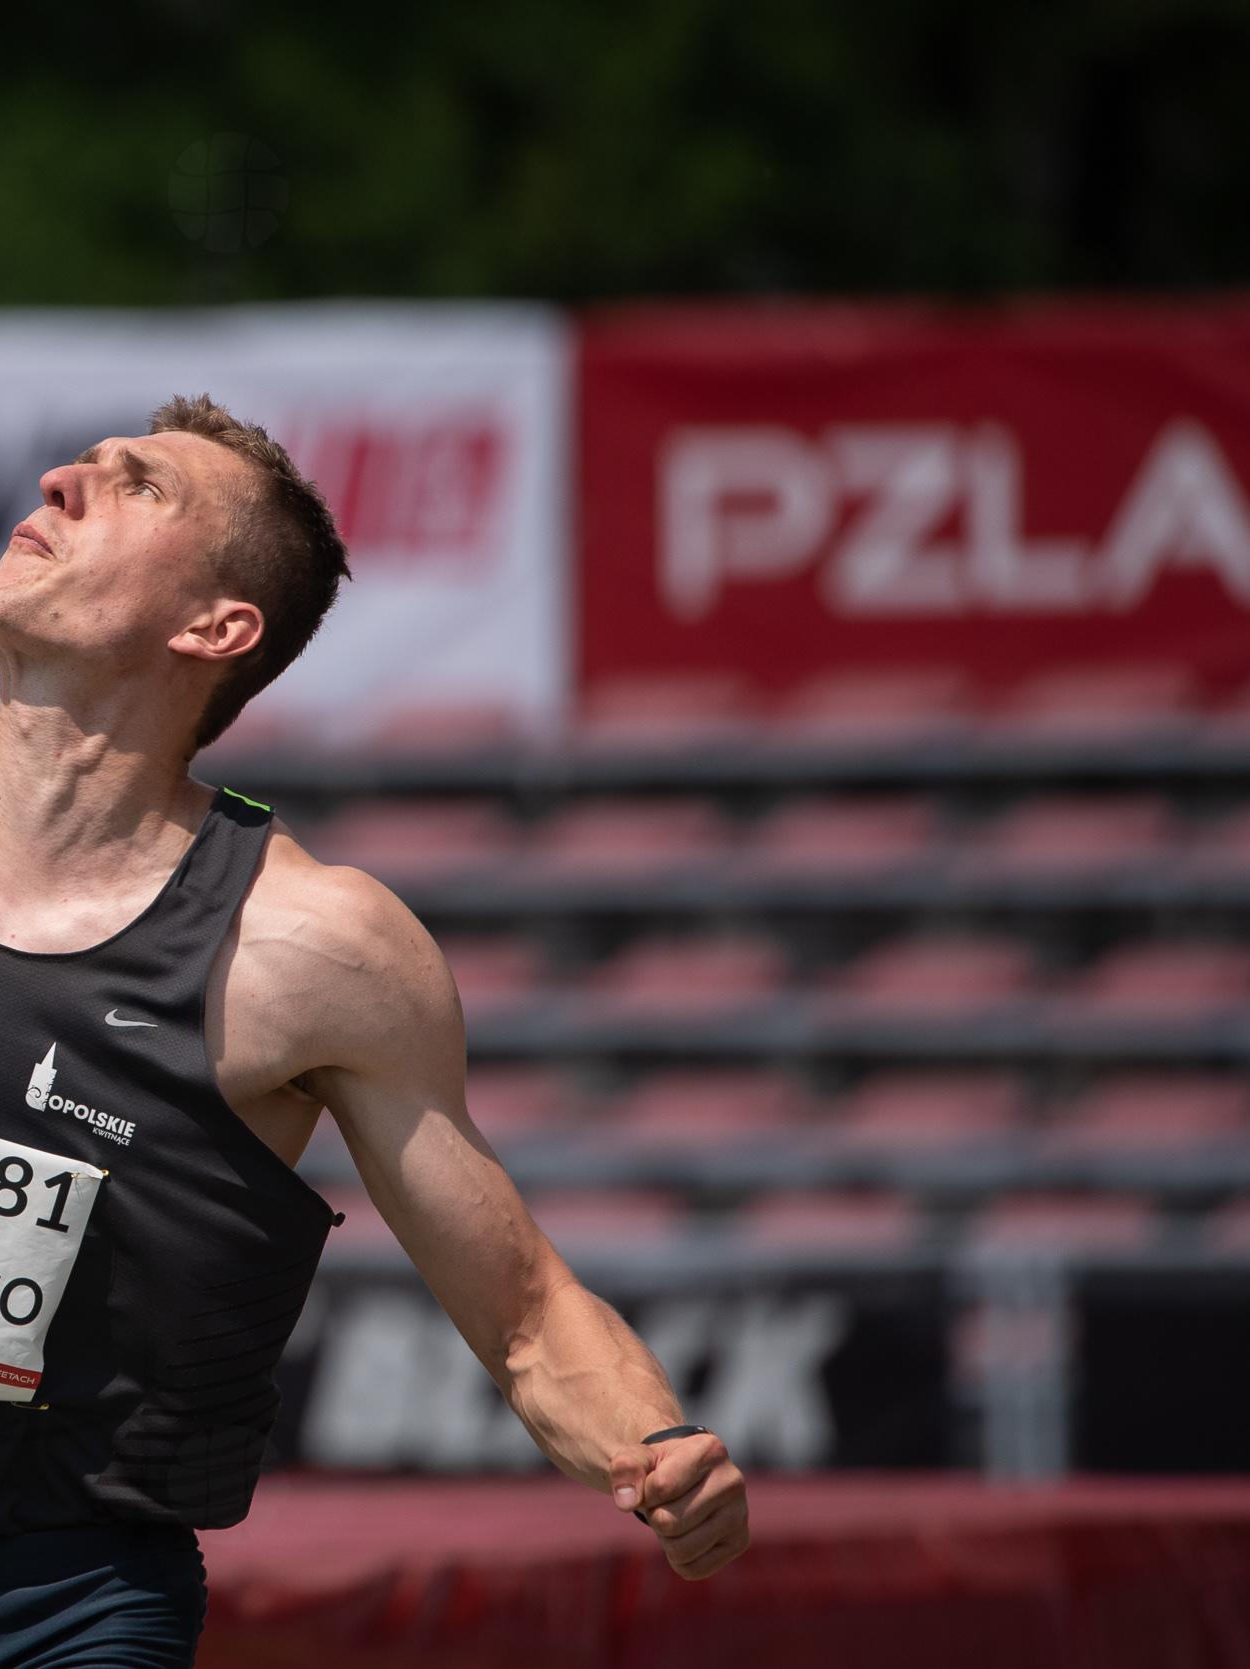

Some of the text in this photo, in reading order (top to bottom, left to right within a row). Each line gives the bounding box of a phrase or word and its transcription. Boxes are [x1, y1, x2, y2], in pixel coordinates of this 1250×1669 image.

[658, 415, 1250, 624] PZLA
[48, 1094, 137, 1139] OPOLSKIE
[92, 1126, 131, 1147] KWITNĄCE
